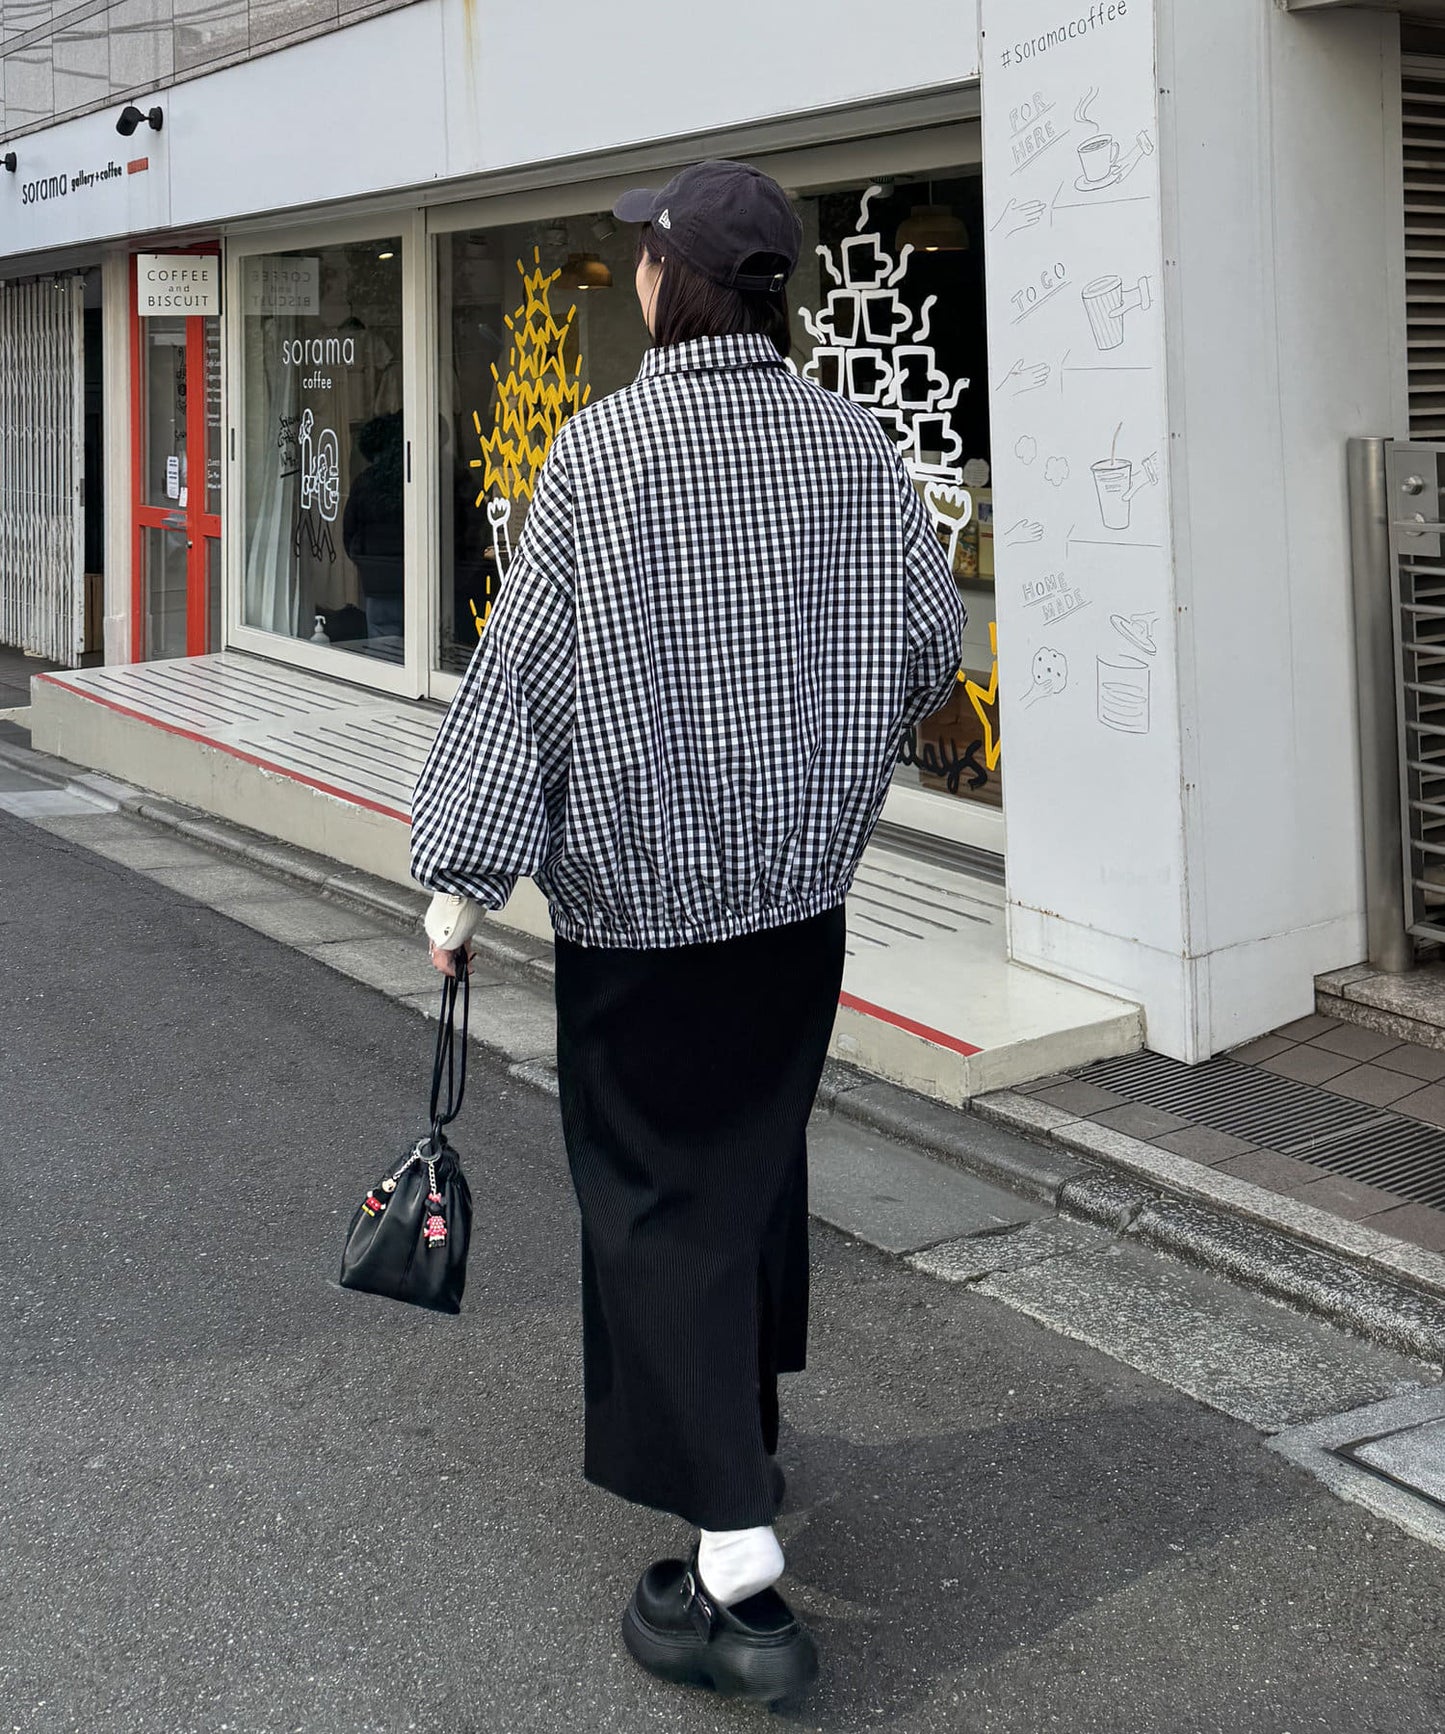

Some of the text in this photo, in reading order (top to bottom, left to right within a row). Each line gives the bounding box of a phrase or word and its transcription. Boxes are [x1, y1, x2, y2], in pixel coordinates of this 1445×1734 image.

[1001, 0, 1127, 68] #soramacoffee
[1009, 91, 1046, 132] FOR
[1012, 120, 1055, 164] HERE
[22, 174, 67, 205] sorama
[147, 270, 209, 281] COFFEE
[168, 284, 190, 292] and
[1011, 262, 1065, 312] TO GO
[147, 295, 209, 307] BISCUIT
[282, 338, 355, 365] sorama
[303, 370, 332, 389] coffee
[1022, 572, 1068, 601] HOME
